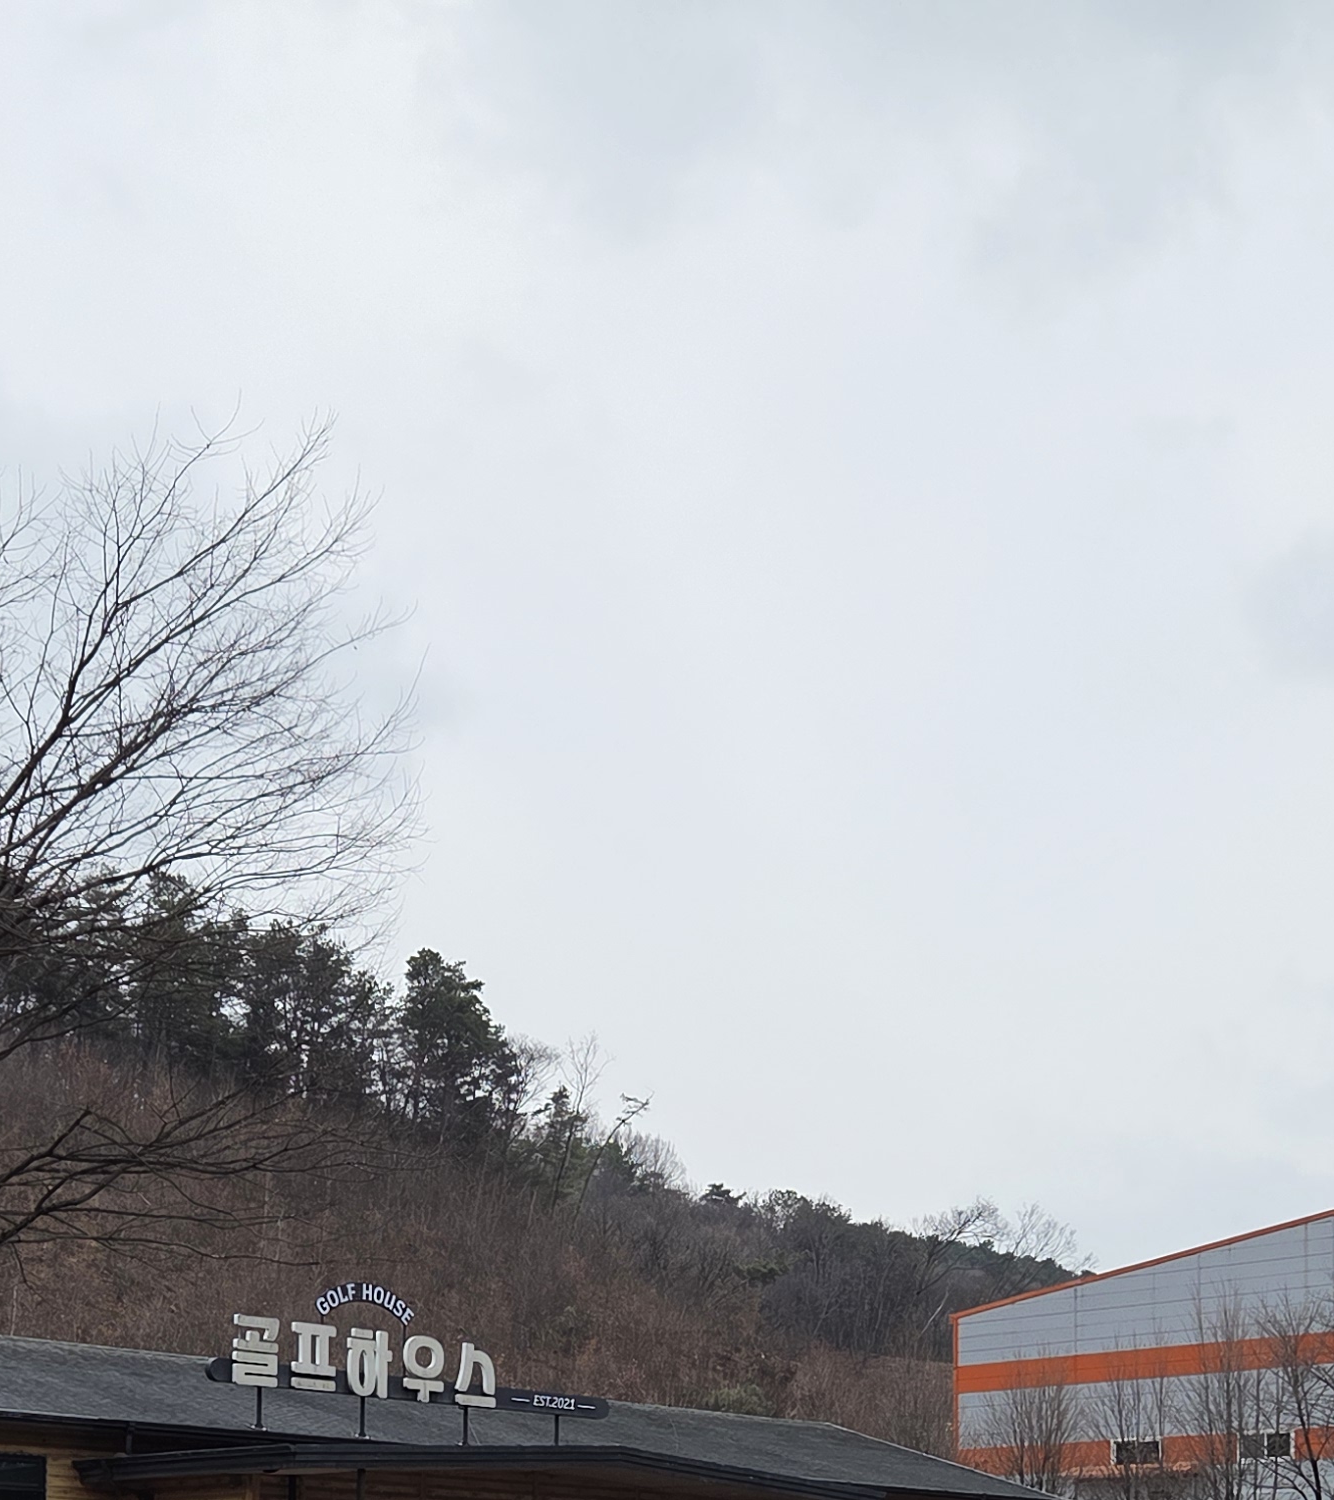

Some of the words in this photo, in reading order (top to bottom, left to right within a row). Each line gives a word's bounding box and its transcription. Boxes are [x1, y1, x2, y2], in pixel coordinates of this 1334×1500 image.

[316, 1283, 357, 1315] GOLF
[362, 1283, 415, 1326] HOUSE
[232, 1313, 496, 1408] 골프하우스
